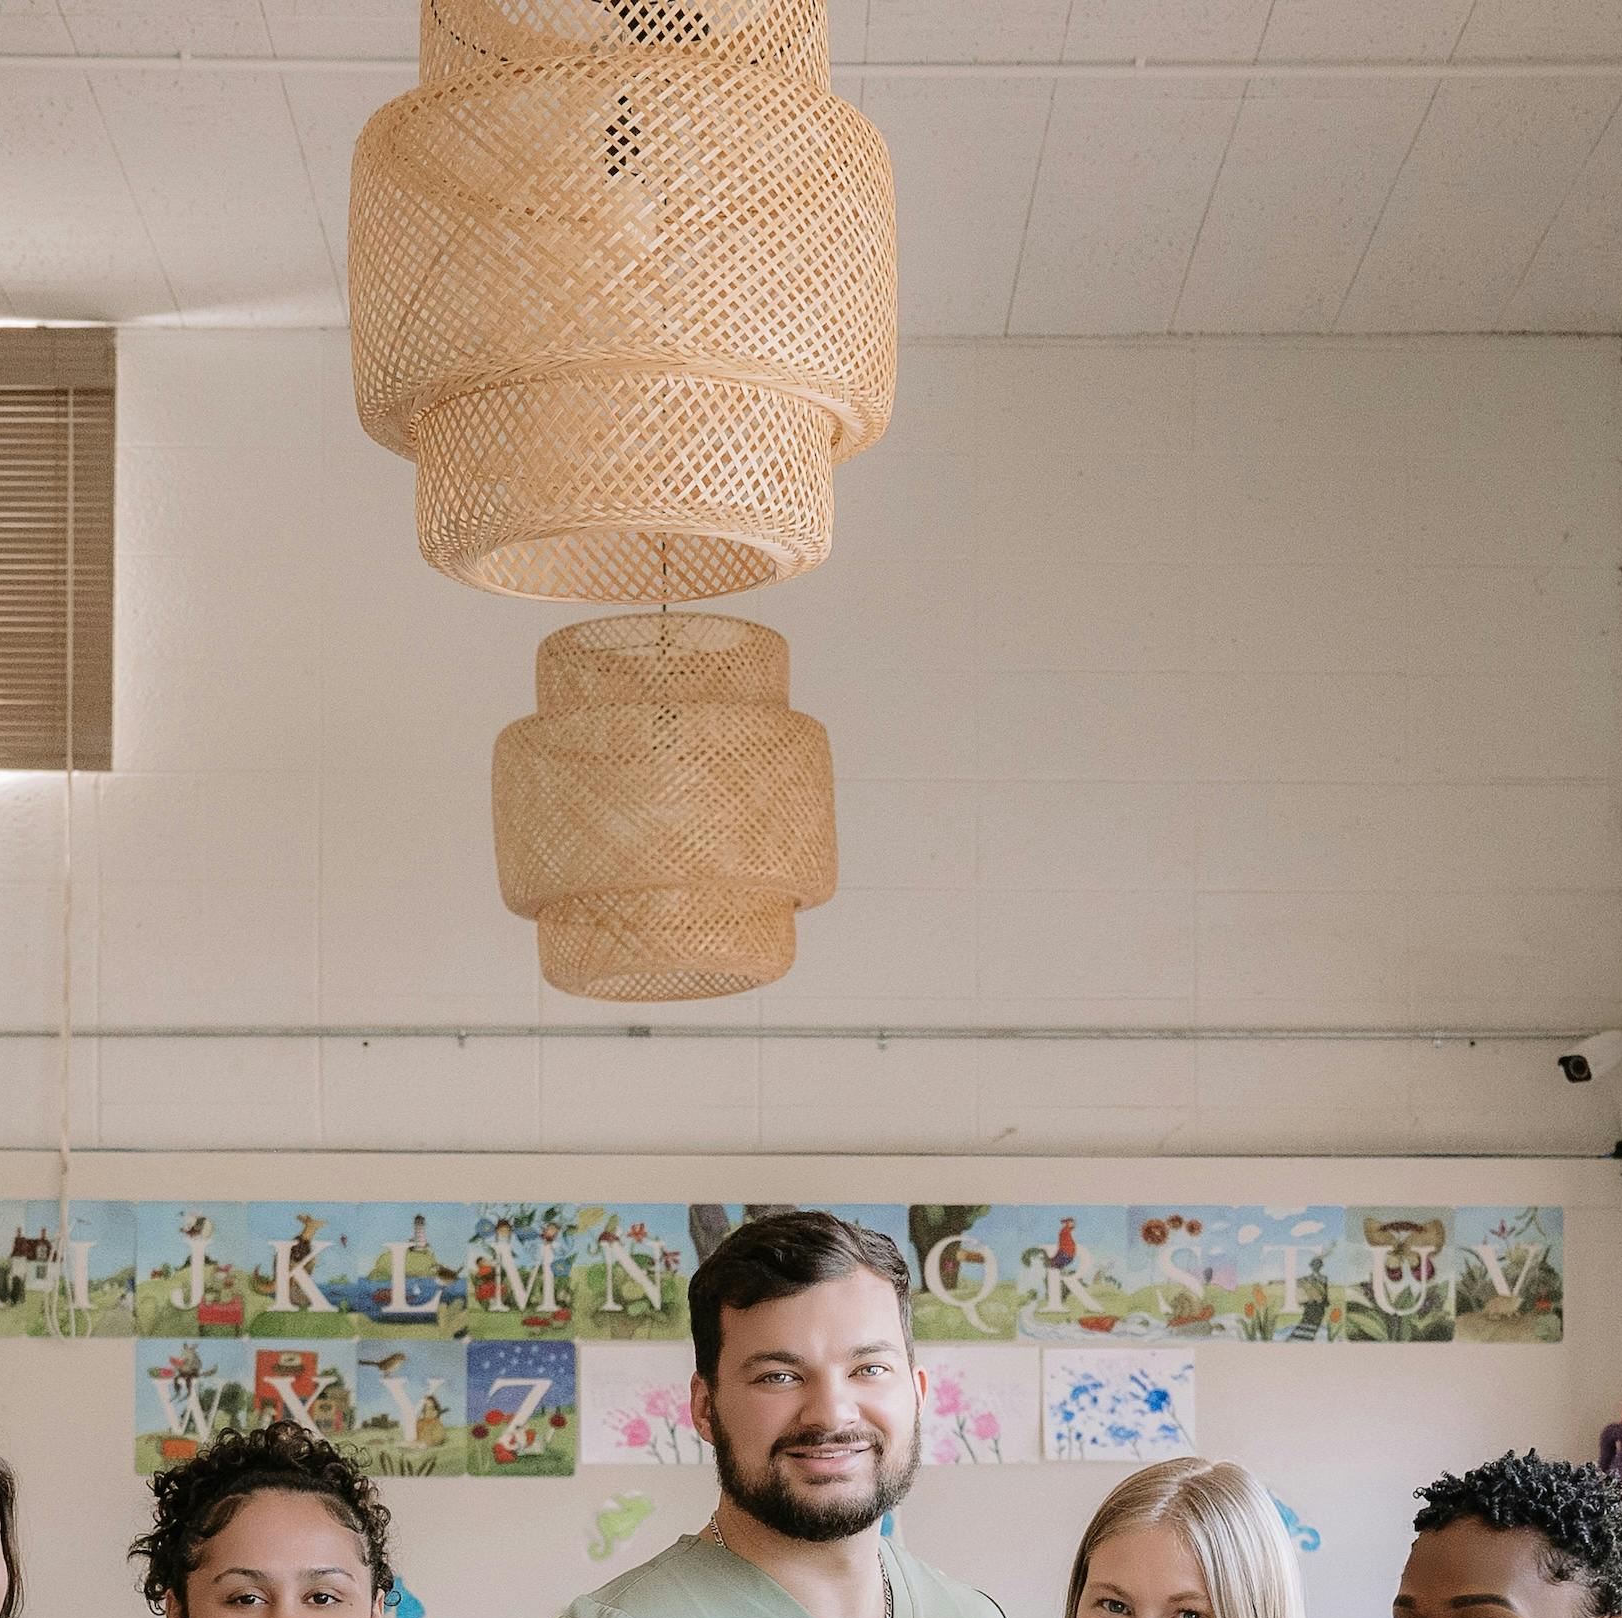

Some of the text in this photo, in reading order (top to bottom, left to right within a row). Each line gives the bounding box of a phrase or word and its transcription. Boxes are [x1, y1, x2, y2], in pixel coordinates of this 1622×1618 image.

[68, 1239, 97, 1311] I
[169, 1237, 211, 1311] J
[267, 1240, 341, 1313] K
[380, 1241, 442, 1314] L
[488, 1240, 559, 1313] M
[597, 1240, 667, 1313] N
[924, 1235, 999, 1333] Q
[1039, 1243, 1104, 1313] R
[1157, 1235, 1205, 1315] S
[1261, 1245, 1329, 1314] T
[1364, 1245, 1445, 1316] U
[1476, 1245, 1542, 1308] V
[152, 1375, 553, 1455] W X Y Z
